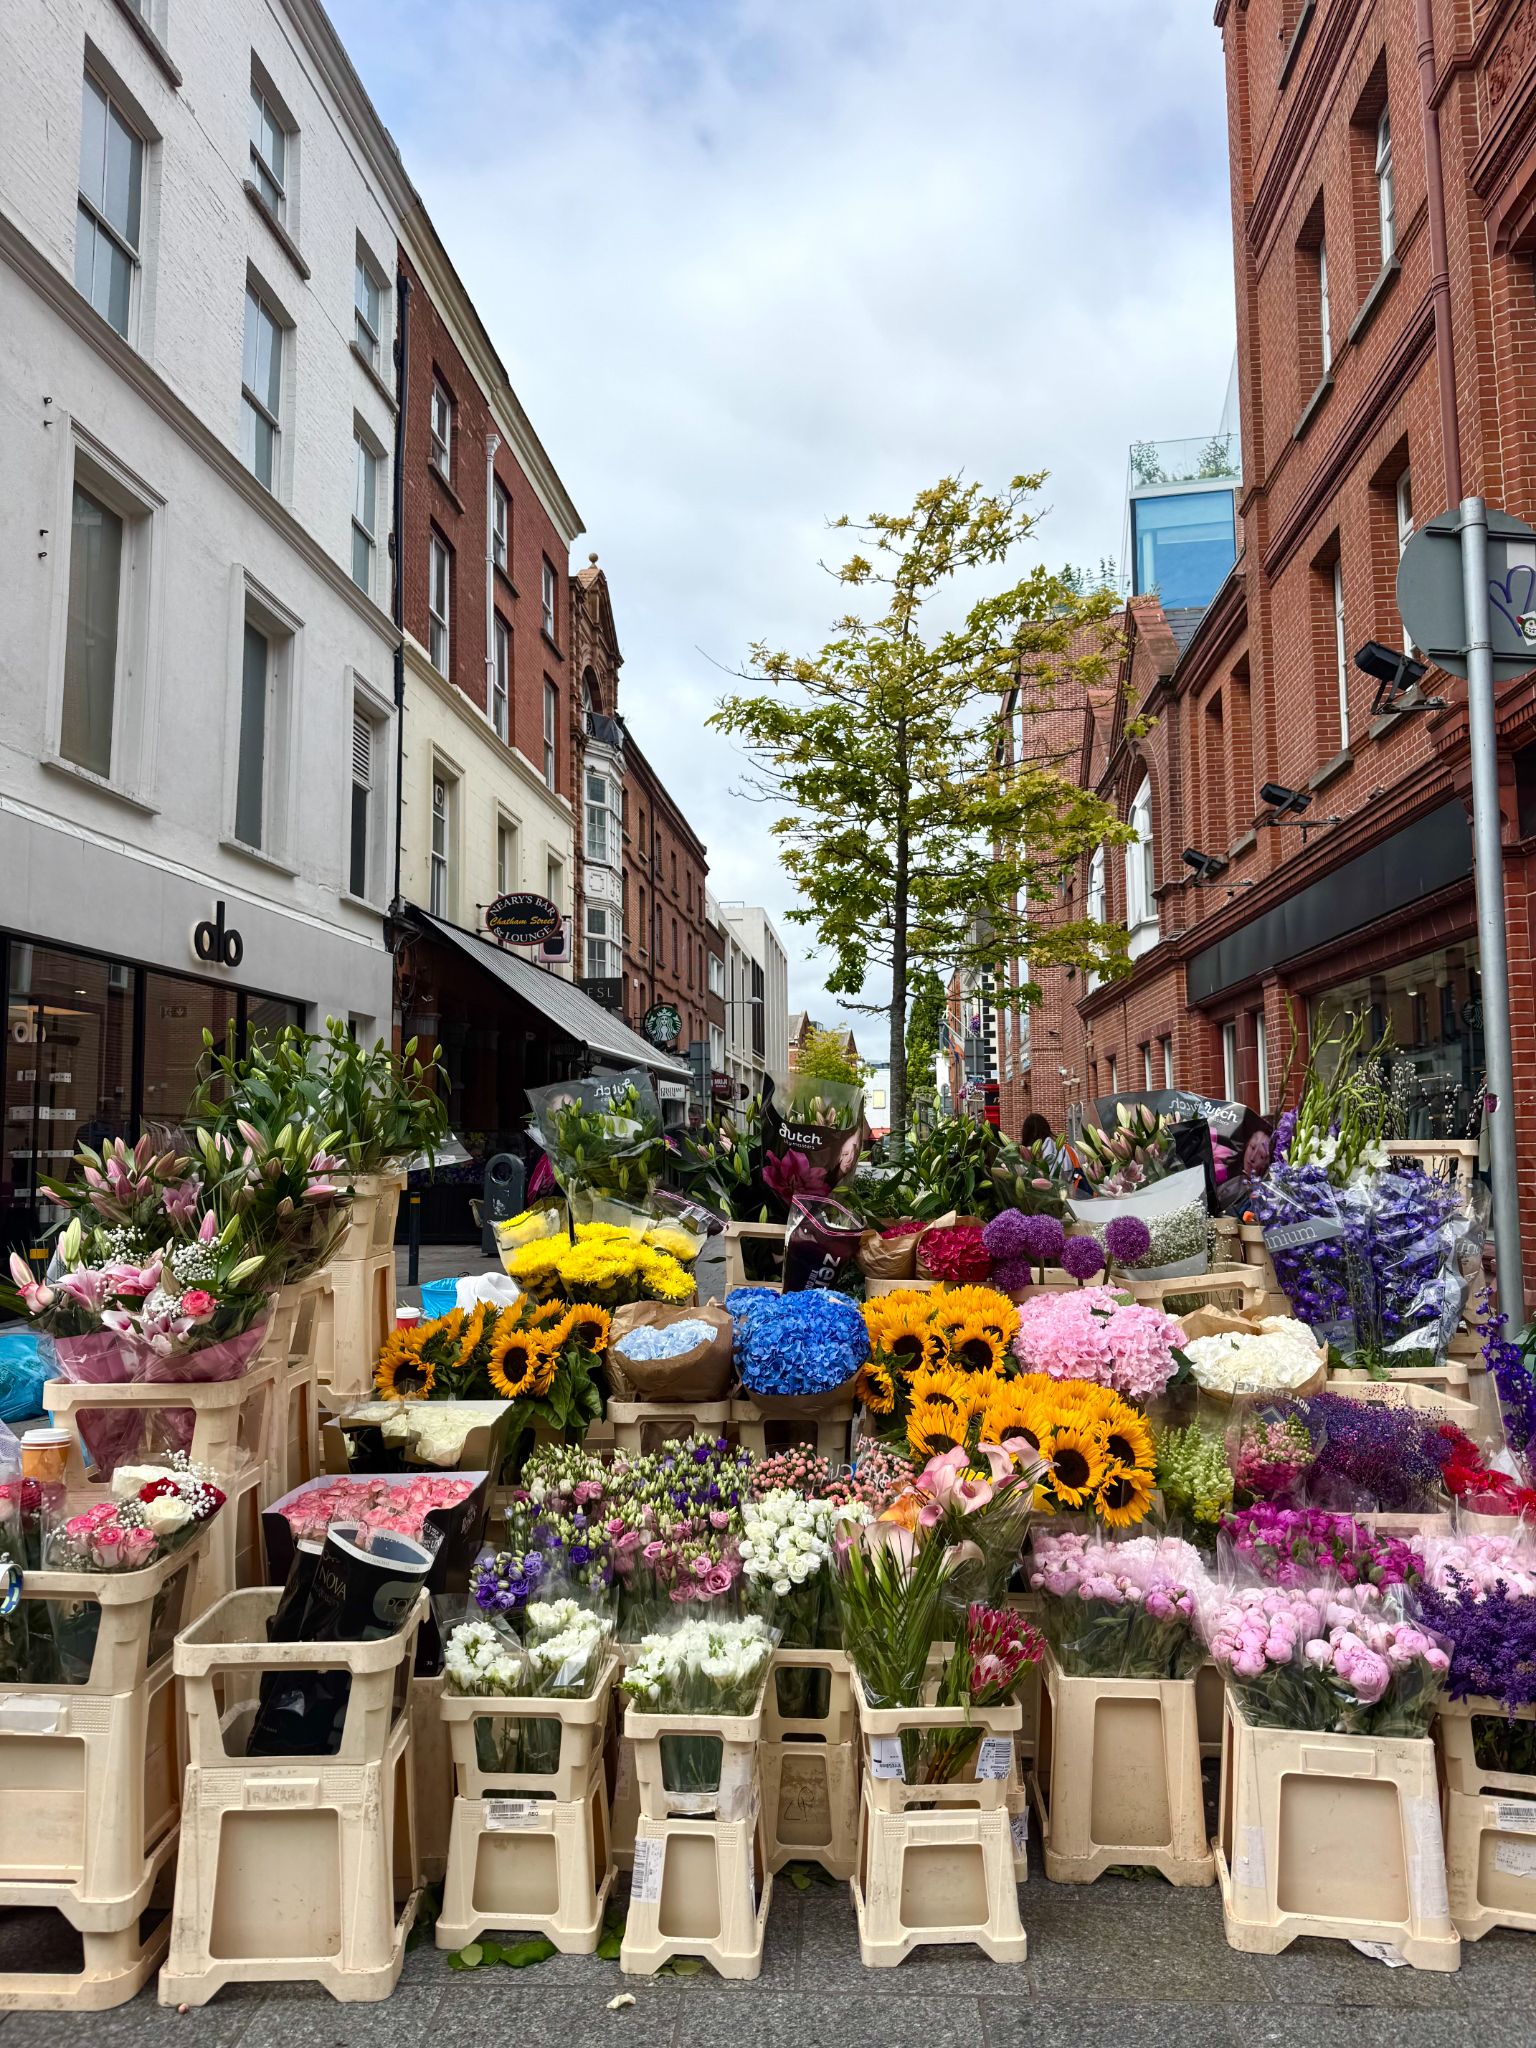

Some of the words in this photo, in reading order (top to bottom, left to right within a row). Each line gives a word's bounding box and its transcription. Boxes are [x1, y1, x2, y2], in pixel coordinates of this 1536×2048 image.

[490, 895, 533, 916] NEARY'S
[535, 898, 556, 917] BAR
[490, 916, 527, 927] Chatham
[530, 915, 555, 925] Street
[194, 900, 243, 968] alo
[494, 926, 504, 937] &
[505, 925, 551, 942] LOUNGE
[779, 1122, 823, 1145] dutch
[319, 1565, 347, 1601] NOVA
